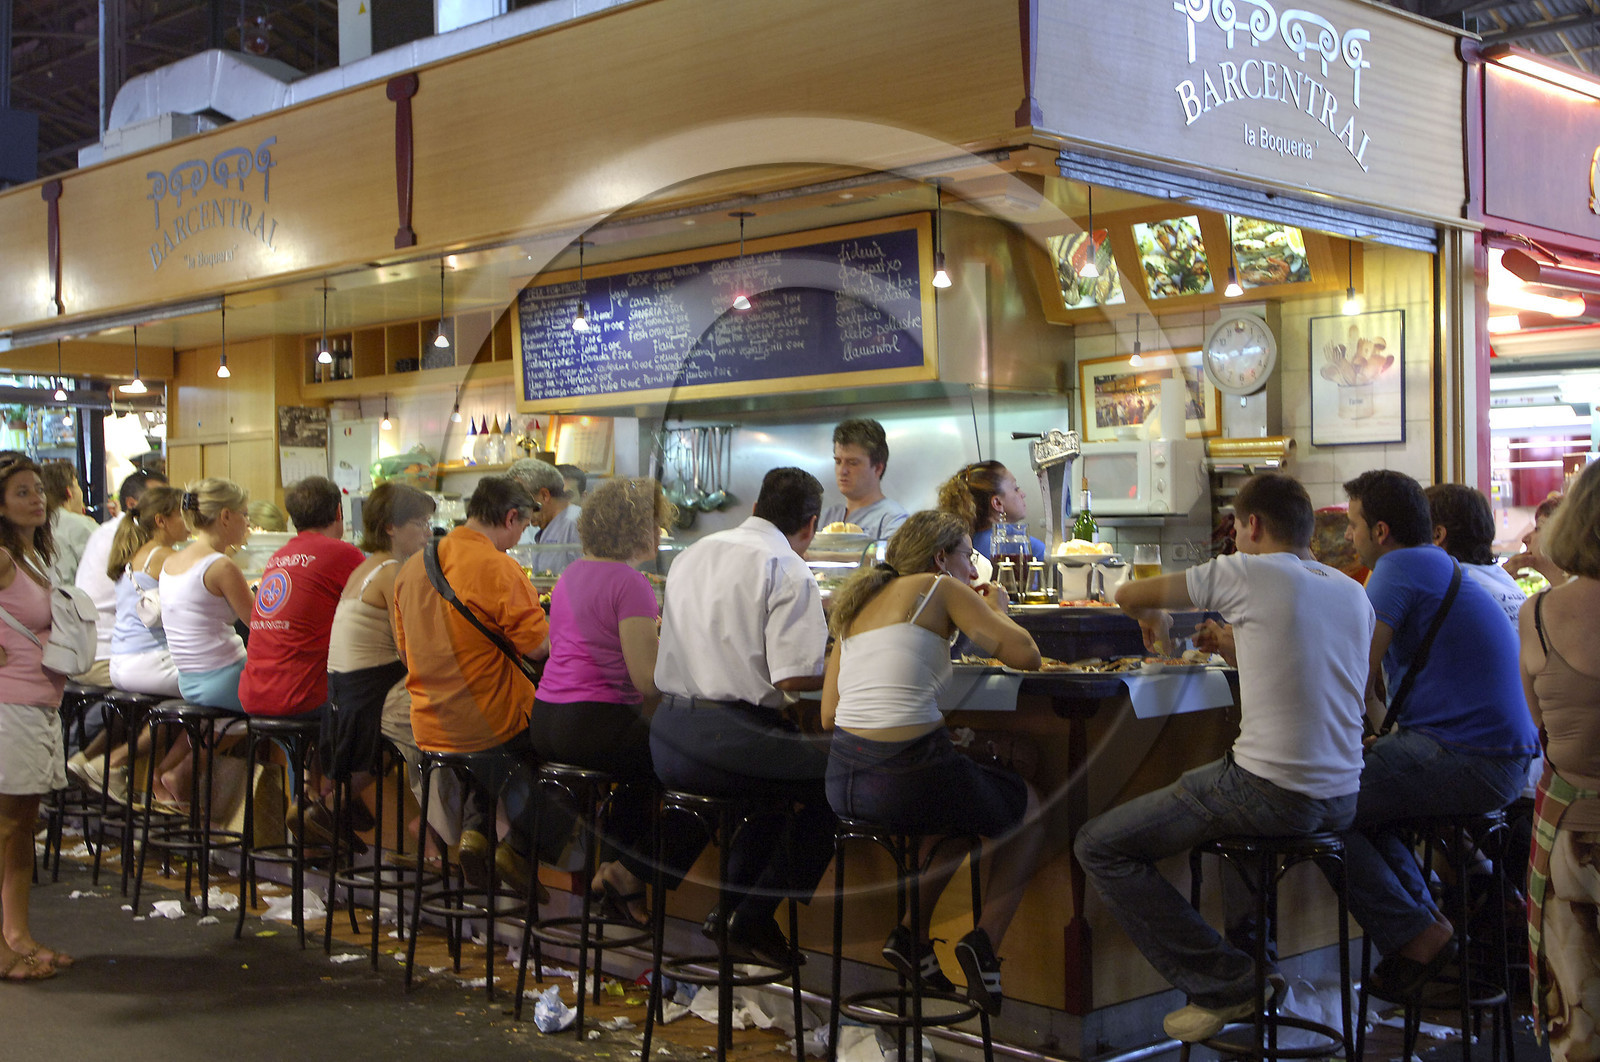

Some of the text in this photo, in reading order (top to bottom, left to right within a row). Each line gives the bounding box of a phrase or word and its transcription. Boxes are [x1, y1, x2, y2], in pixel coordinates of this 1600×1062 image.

[1175, 59, 1371, 173] BARCENTRAL
[1244, 123, 1255, 146] la
[149, 198, 278, 271] BARCENTRAL
[267, 554, 317, 568] UGBY
